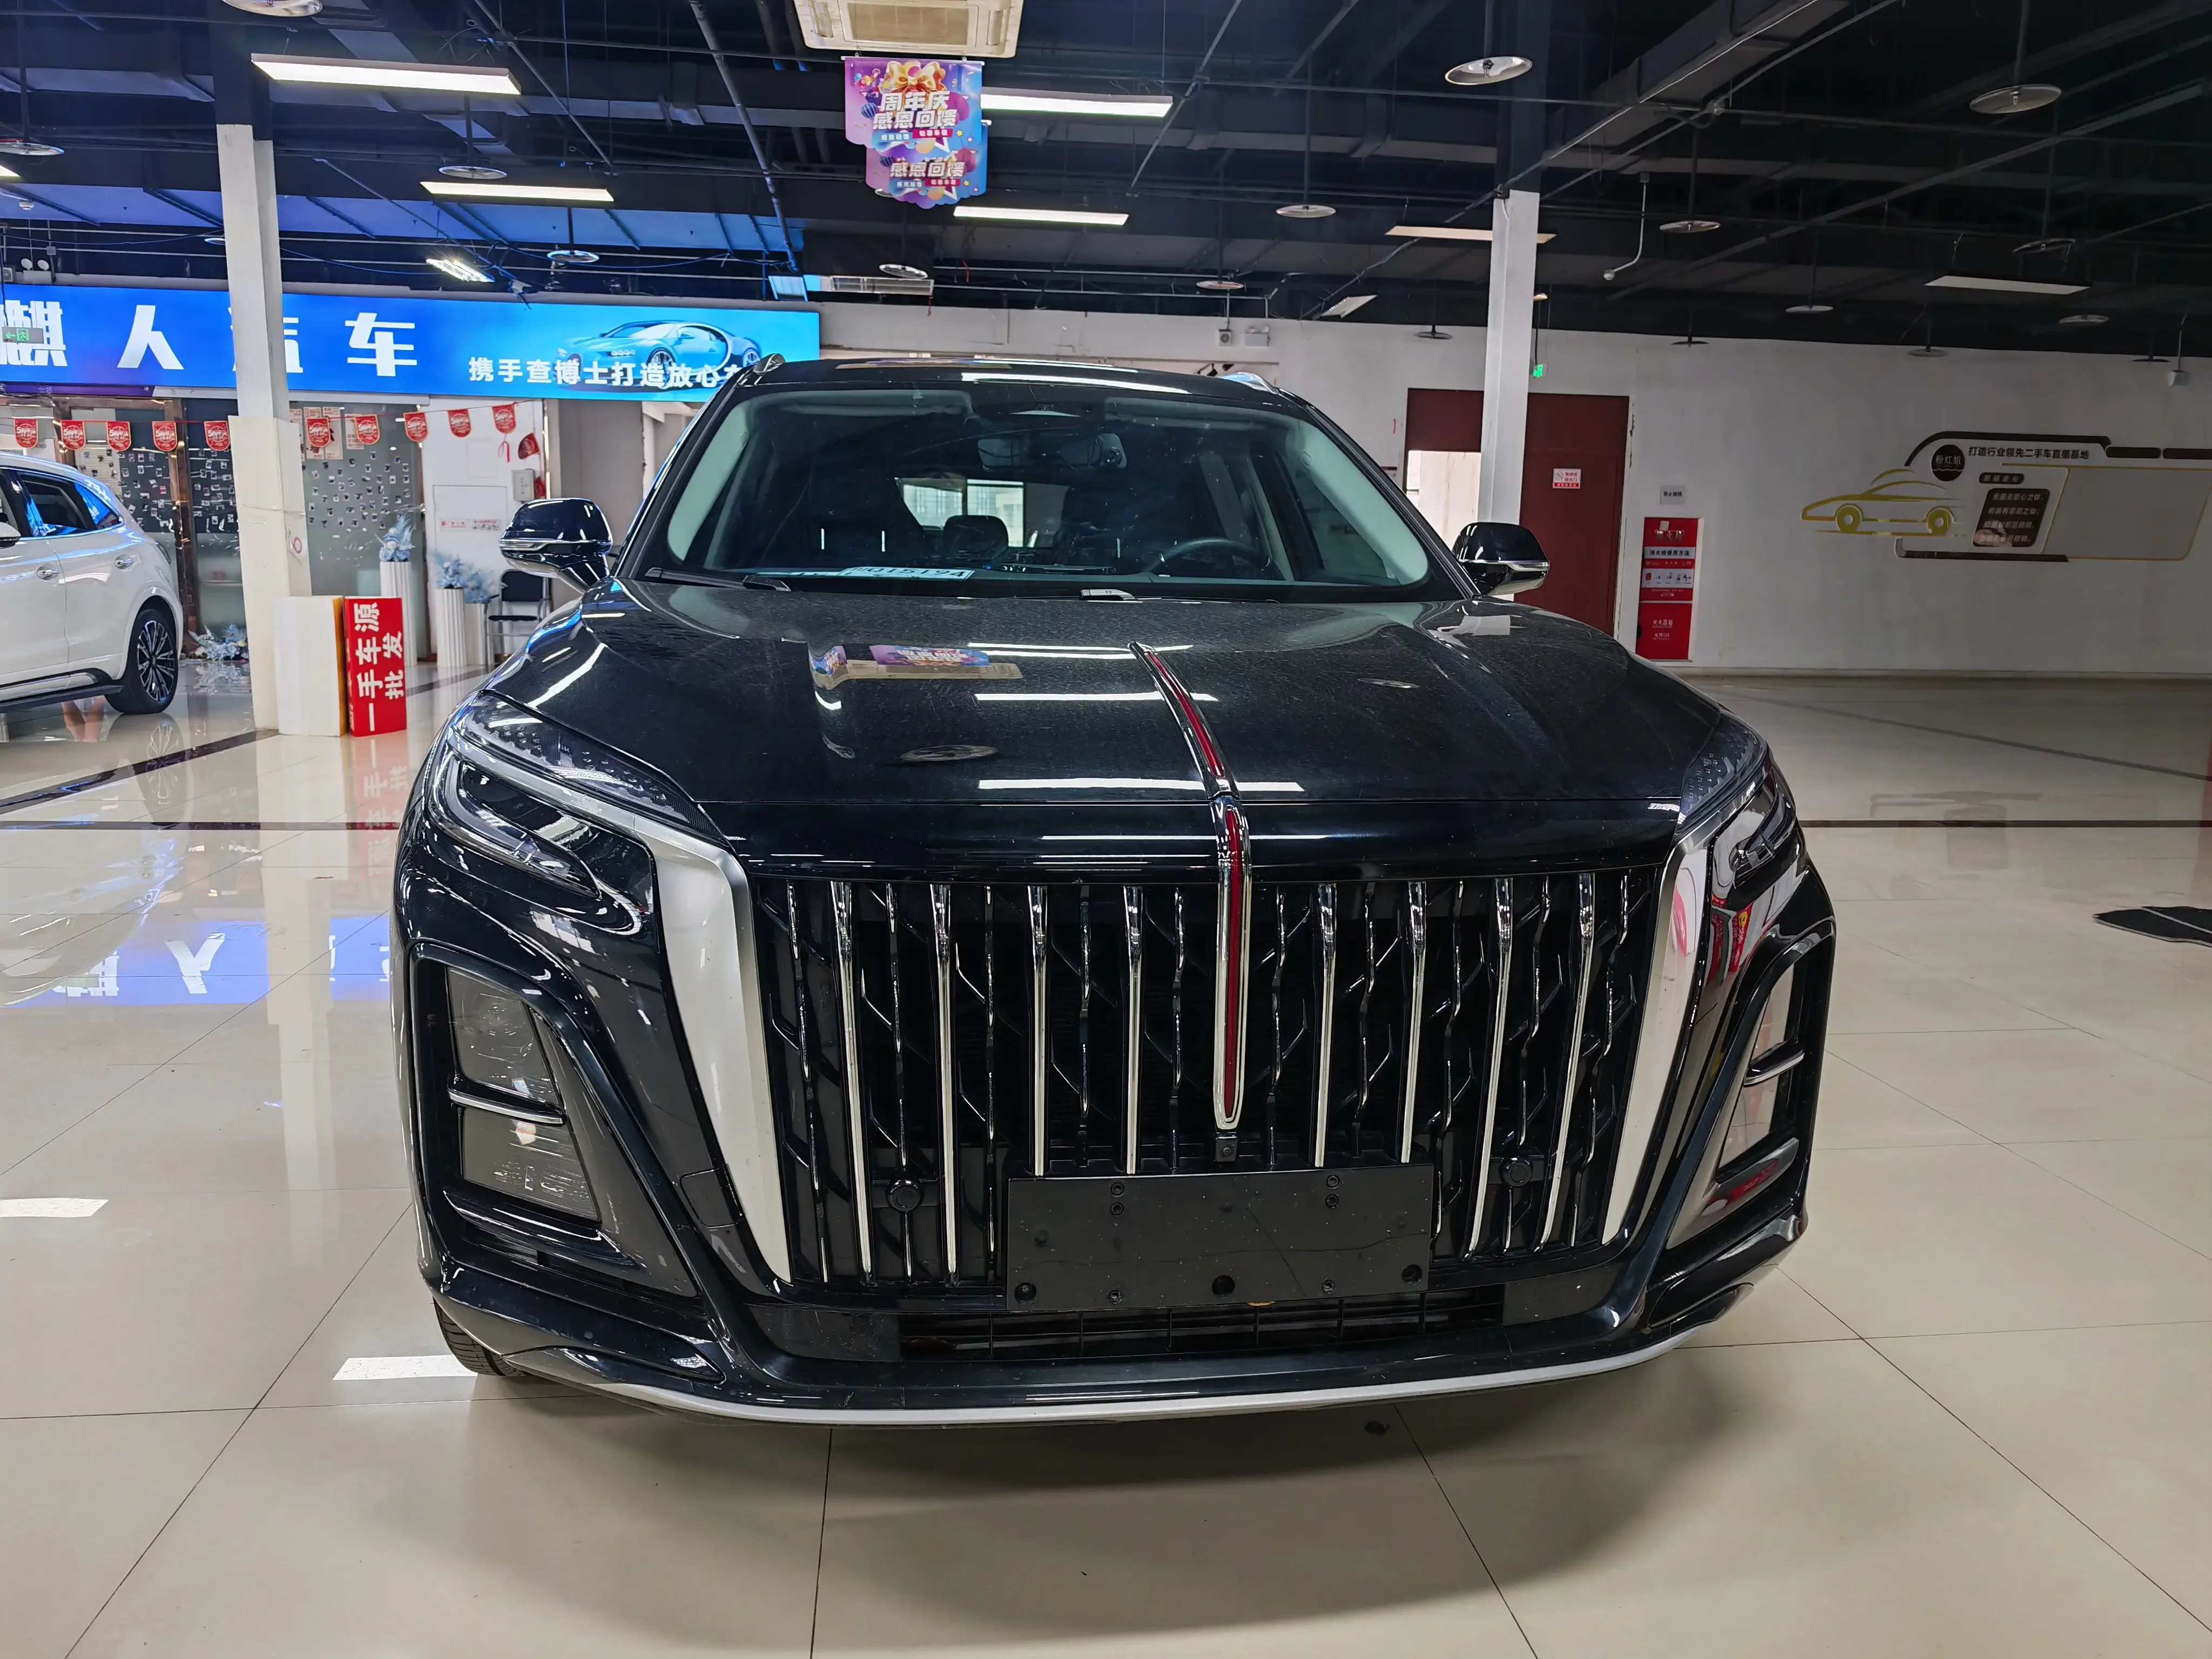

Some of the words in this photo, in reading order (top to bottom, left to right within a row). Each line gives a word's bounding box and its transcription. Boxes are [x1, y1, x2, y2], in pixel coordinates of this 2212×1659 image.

[873, 109, 957, 129] 感恩回馈
[881, 91, 950, 111] 周年庆
[890, 161, 966, 178] 感恩回馈
[0, 299, 417, 377] 麒人车
[353, 602, 383, 732] 一手车源
[382, 631, 404, 700] 批发
